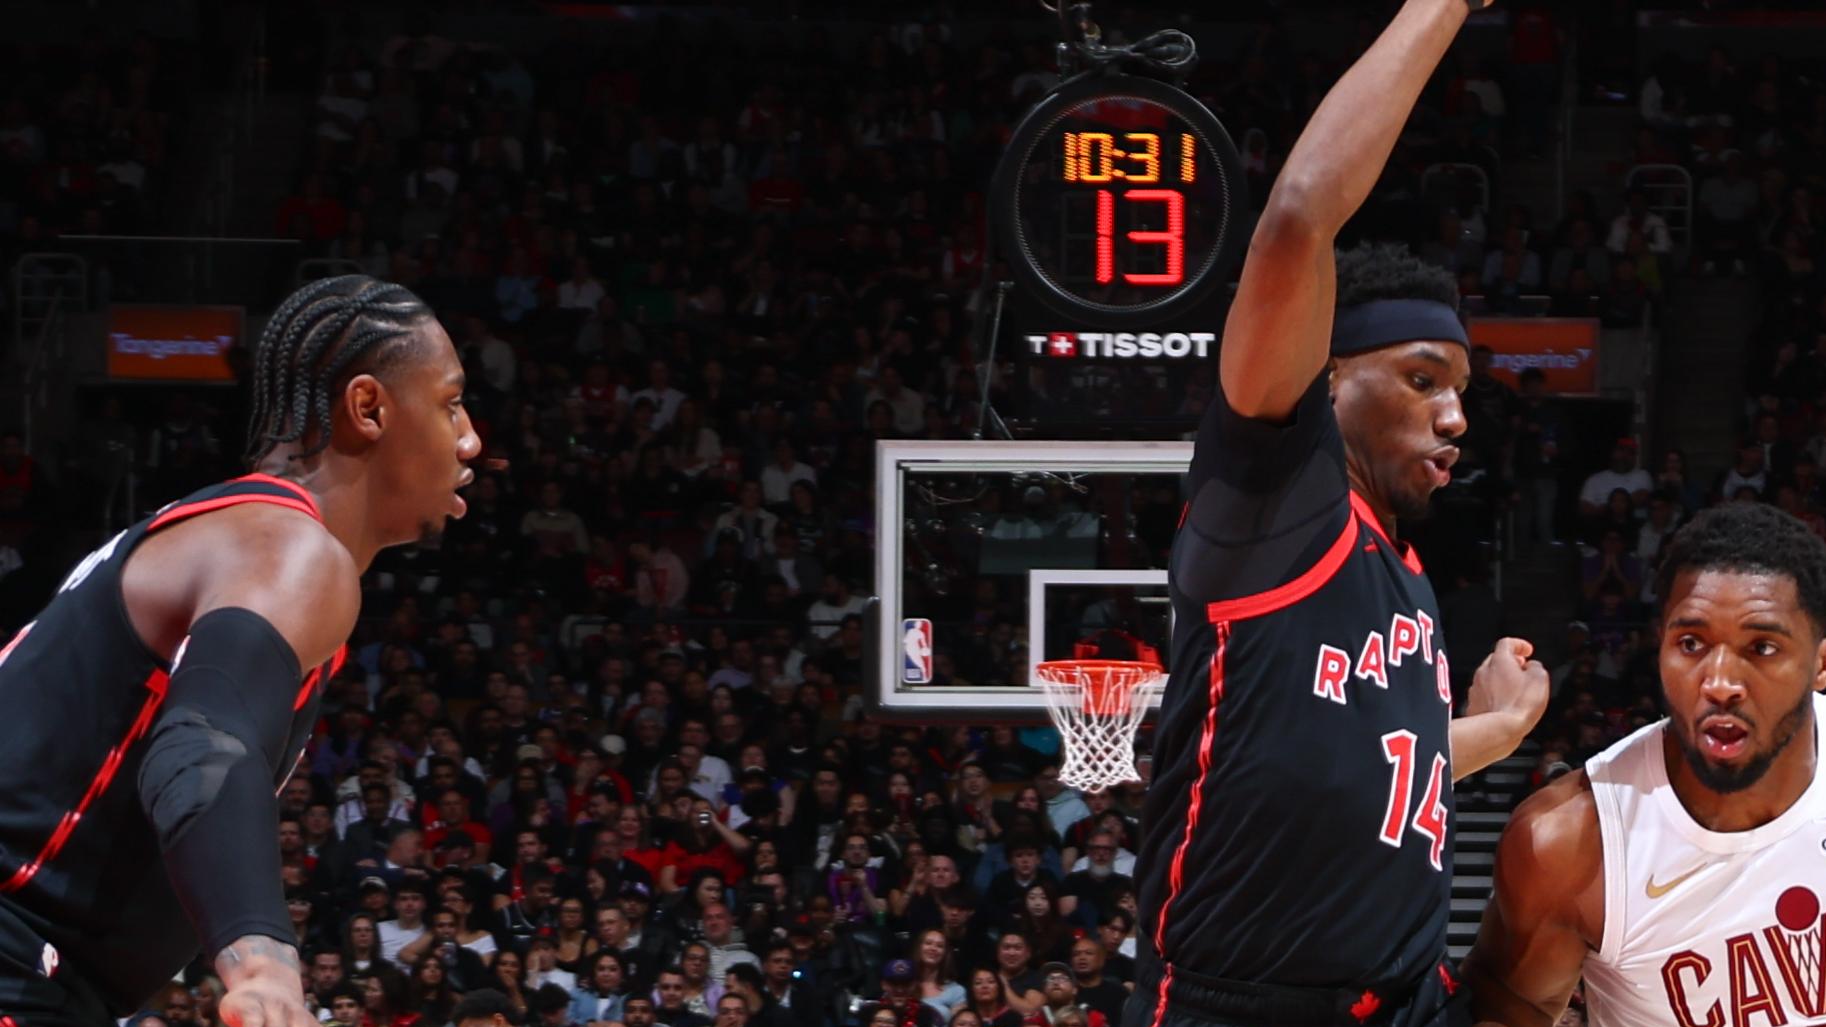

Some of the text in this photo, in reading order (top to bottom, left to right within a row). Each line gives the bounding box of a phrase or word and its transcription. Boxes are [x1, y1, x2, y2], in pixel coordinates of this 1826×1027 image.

[1063, 132, 1197, 183] 10:31
[1096, 189, 1185, 284] 13
[112, 332, 218, 360] Tangerine
[1078, 332, 1215, 358] TISSOT
[1489, 348, 1578, 373] angerine
[1313, 609, 1453, 705] RAPTO
[1379, 729, 1449, 872] 14
